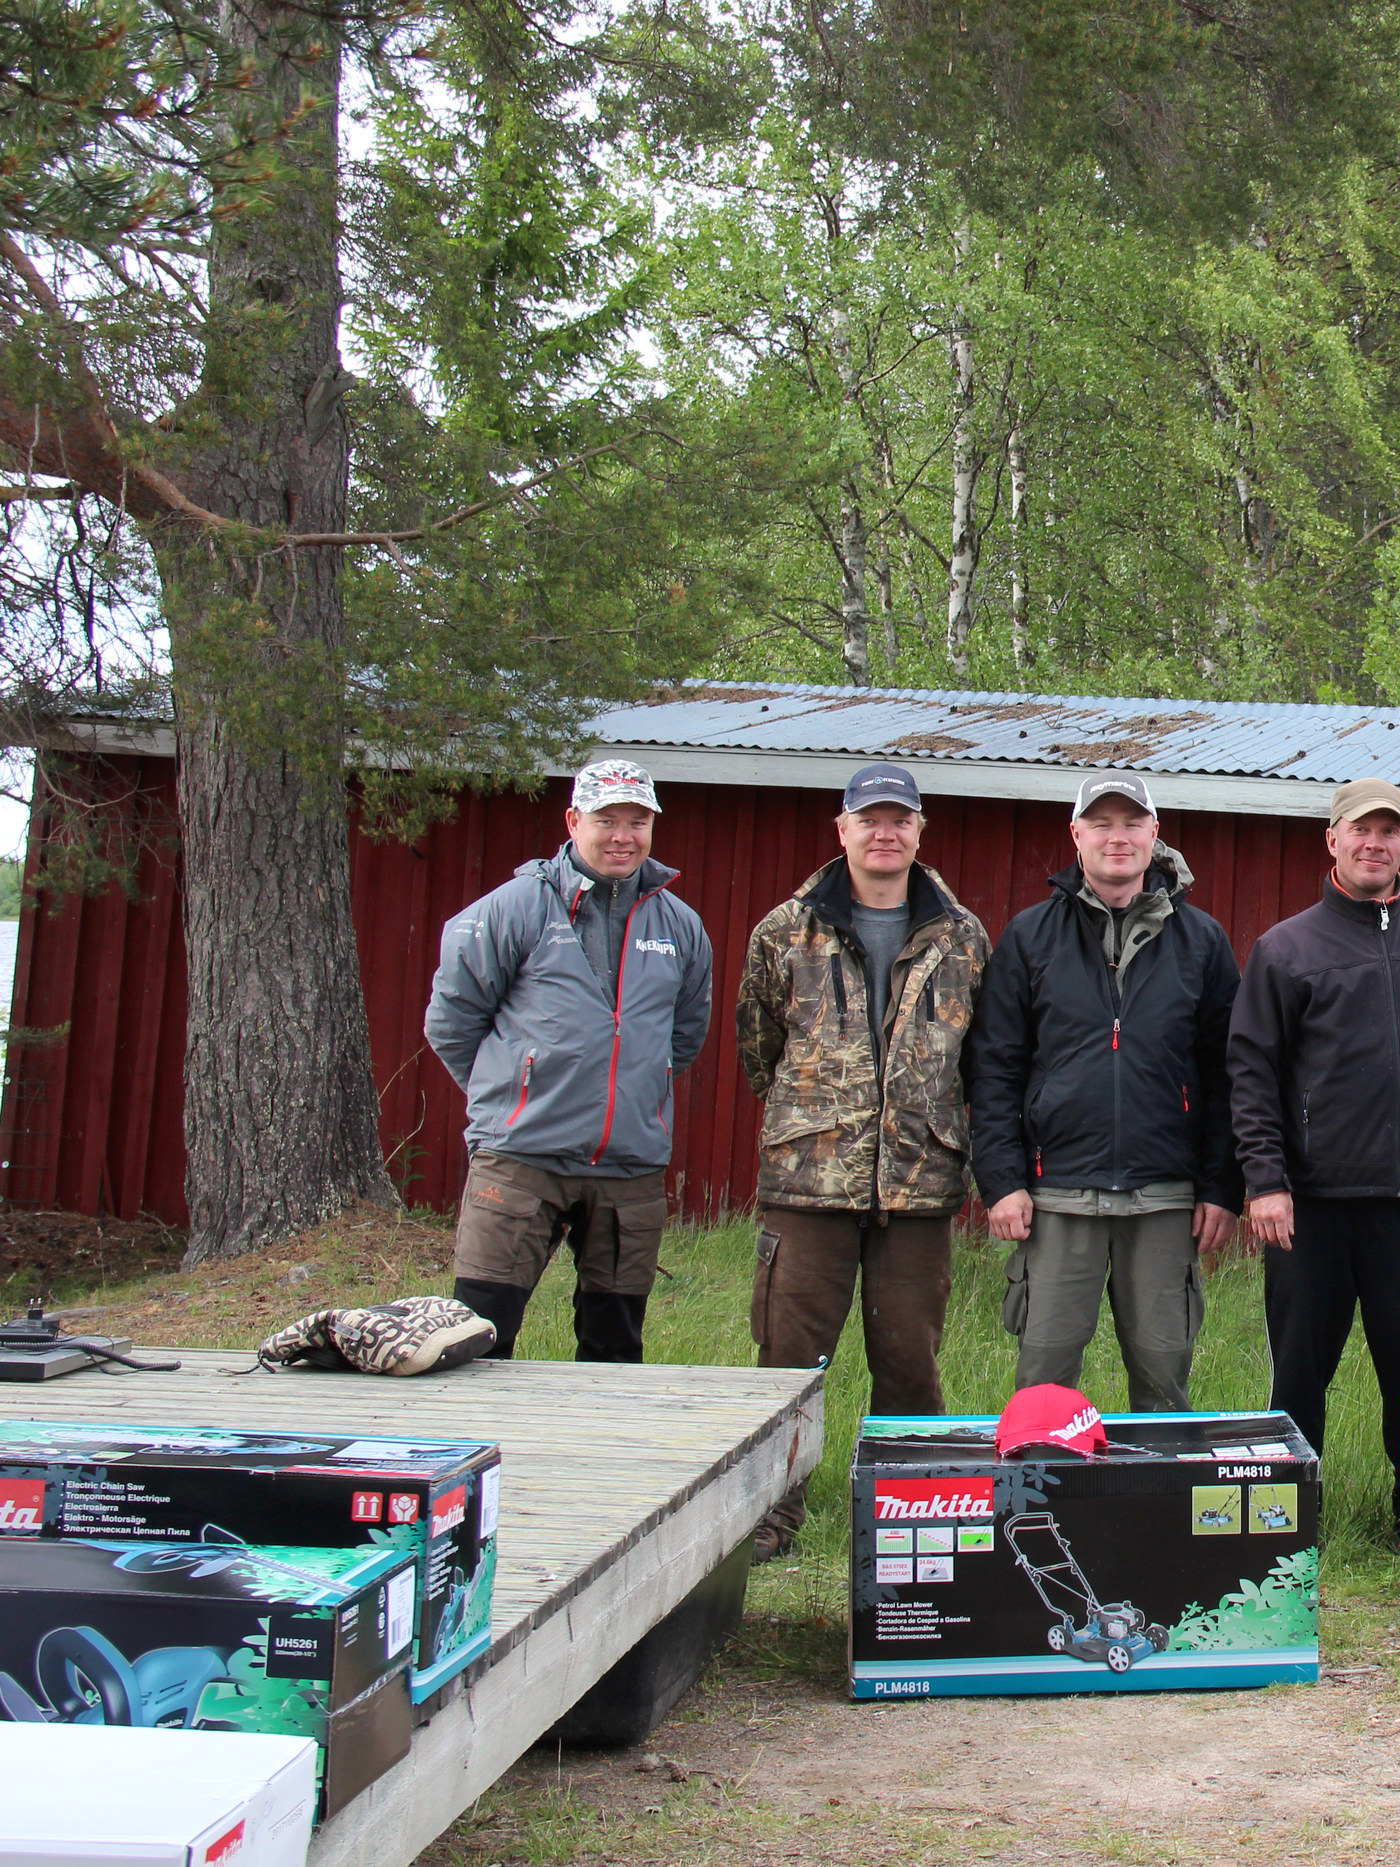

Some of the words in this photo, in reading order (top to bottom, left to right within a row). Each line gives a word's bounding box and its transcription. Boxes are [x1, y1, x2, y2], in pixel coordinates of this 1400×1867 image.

[1218, 1465, 1272, 1479] PLM4818
[66, 1481, 98, 1490] Electric
[100, 1482, 125, 1491] Chain
[127, 1483, 145, 1491] Saw
[66, 1492, 126, 1501] Tronçonneuse
[127, 1494, 171, 1503] Electrique
[65, 1503, 119, 1512] Electrosierra
[64, 1514, 94, 1522] Elektro
[101, 1515, 147, 1525] Motorsäge
[63, 1526, 131, 1535] Электрическая
[133, 1527, 166, 1537] Цепная
[167, 1528, 191, 1536] Пила
[907, 1609, 939, 1617] Thermique
[917, 1617, 939, 1625] Cesped
[275, 1637, 318, 1649] UH5261
[875, 1681, 930, 1694] PLM4818
